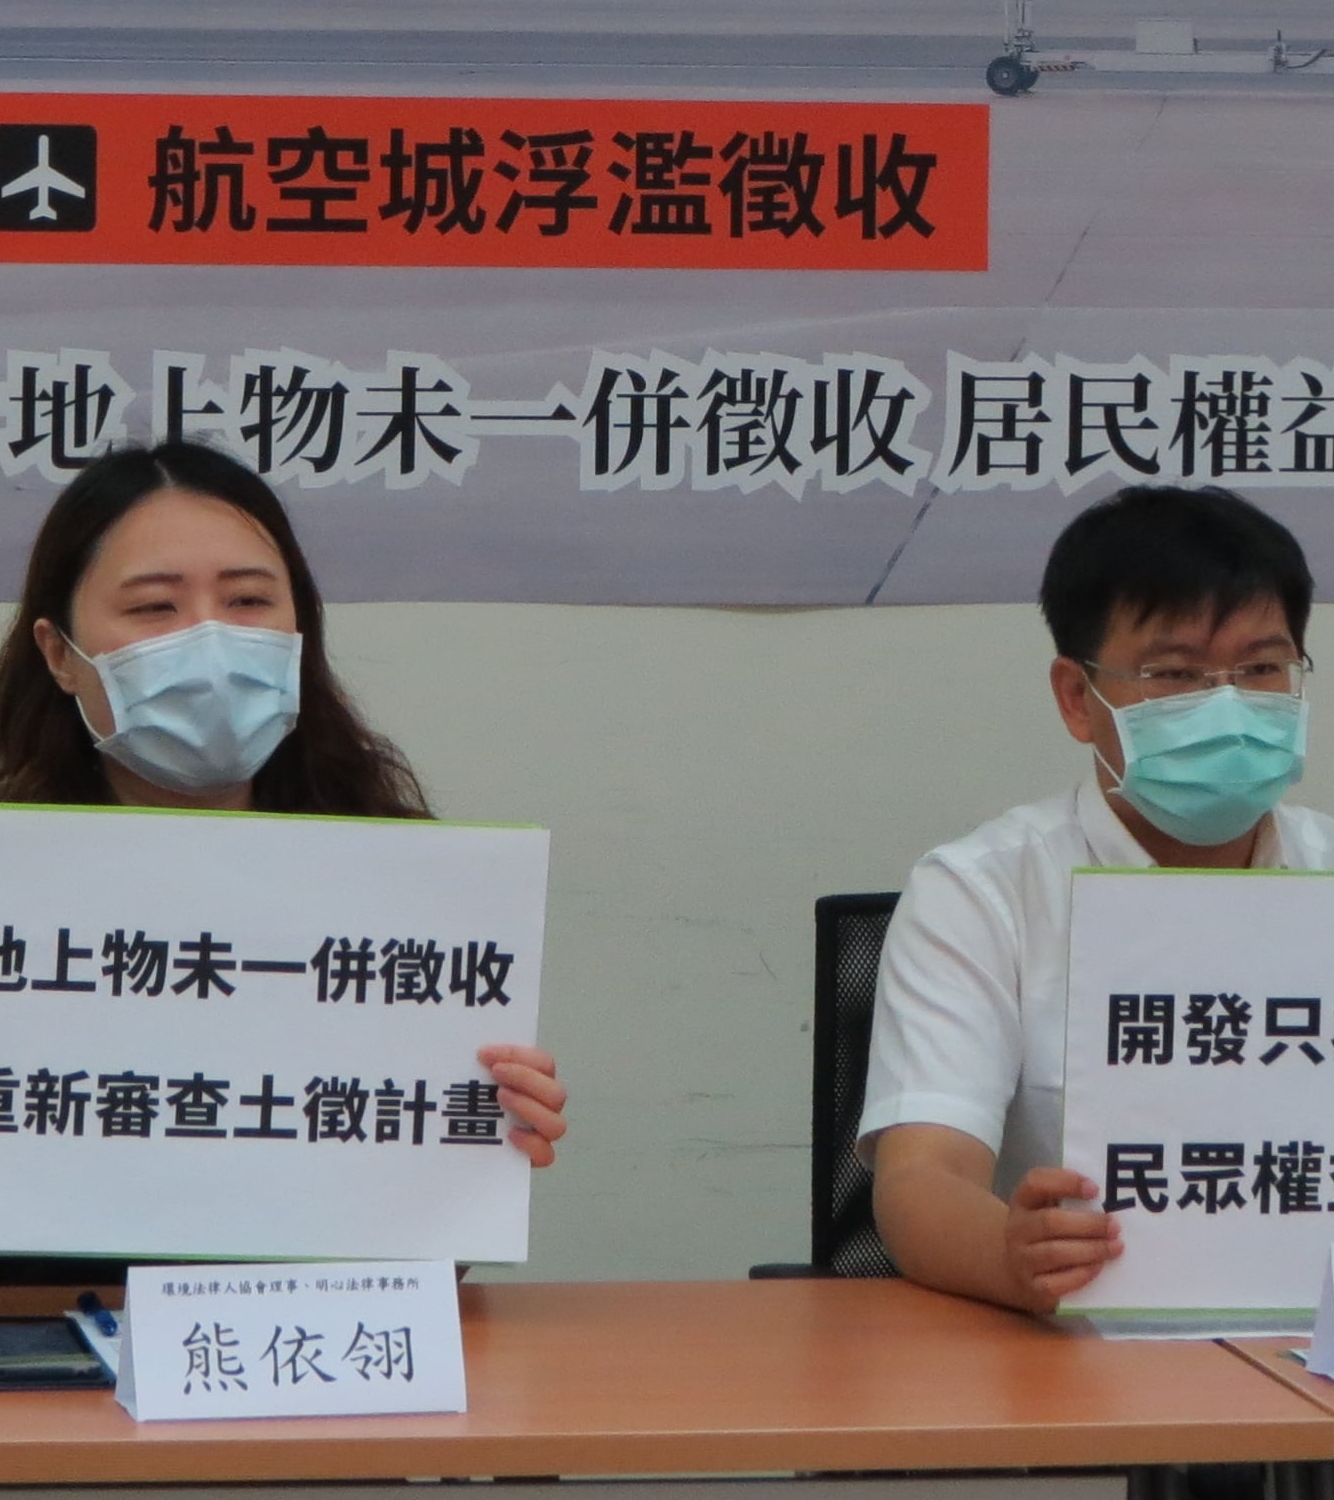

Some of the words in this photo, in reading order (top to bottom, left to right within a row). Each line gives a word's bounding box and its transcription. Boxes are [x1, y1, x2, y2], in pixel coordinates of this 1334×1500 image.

[147, 123, 936, 241] 航空城浮濫徵收
[8, 363, 915, 478] 地上物未一併徵收
[181, 1321, 415, 1396] 熊依翎
